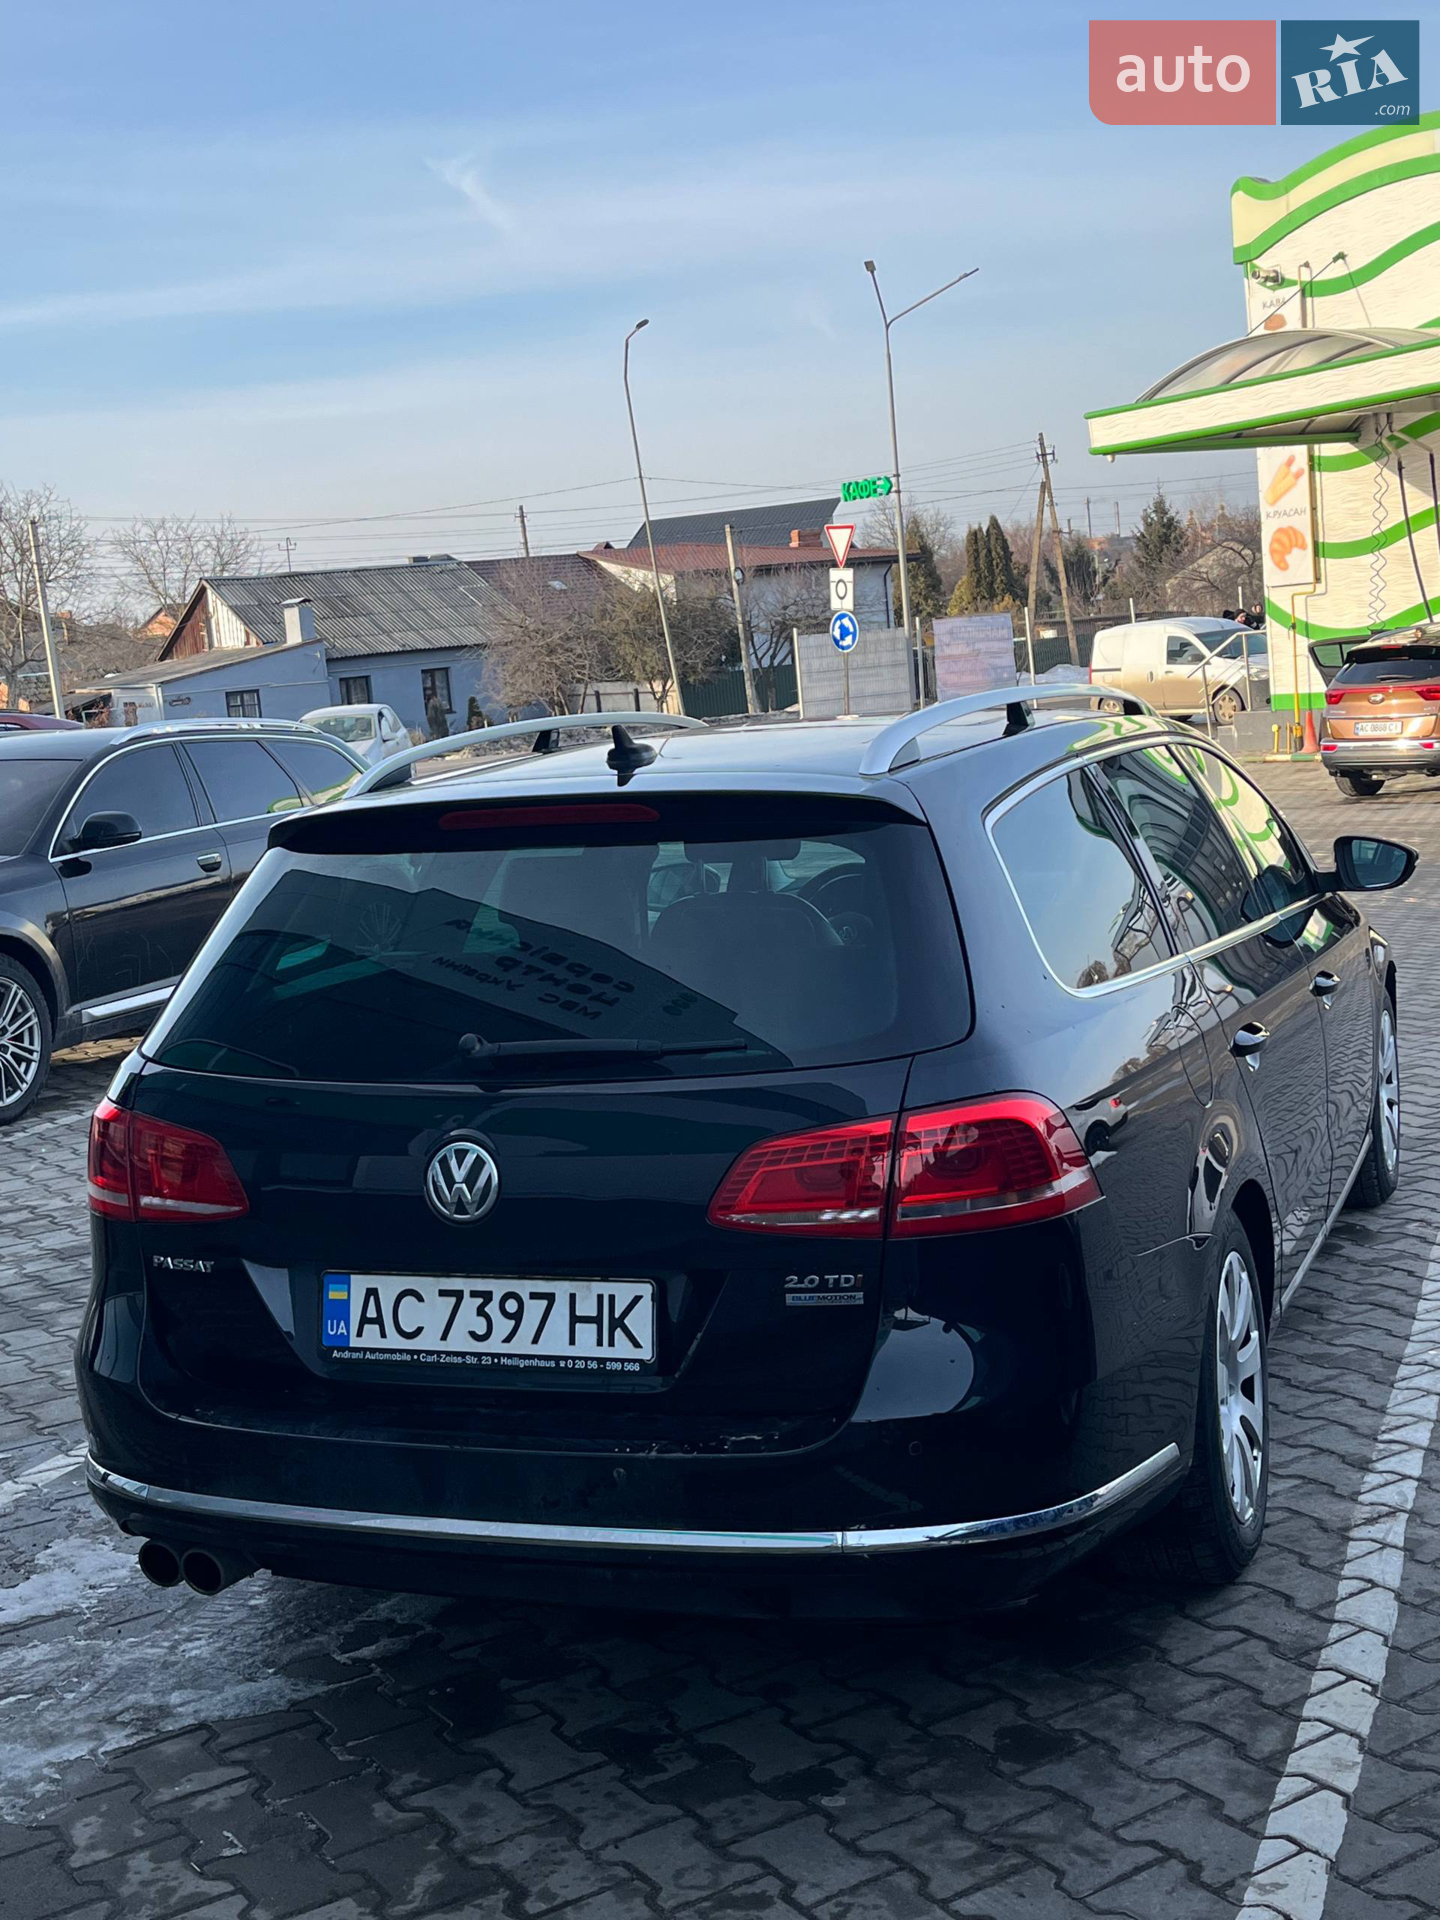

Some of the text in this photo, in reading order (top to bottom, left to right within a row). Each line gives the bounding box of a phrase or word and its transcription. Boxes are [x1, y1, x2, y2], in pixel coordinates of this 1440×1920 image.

[842, 478, 879, 502] КАФЕ
[1266, 507, 1307, 520] КРУАСАН
[153, 1255, 215, 1273] PASSAT
[355, 1287, 644, 1349] AC 7397 HK
[327, 1319, 348, 1337] UA
[364, 1351, 411, 1361] Automobile
[481, 1356, 492, 1364] 23
[500, 1356, 556, 1368] Heiligenhaus
[605, 1361, 622, 1370] 599
